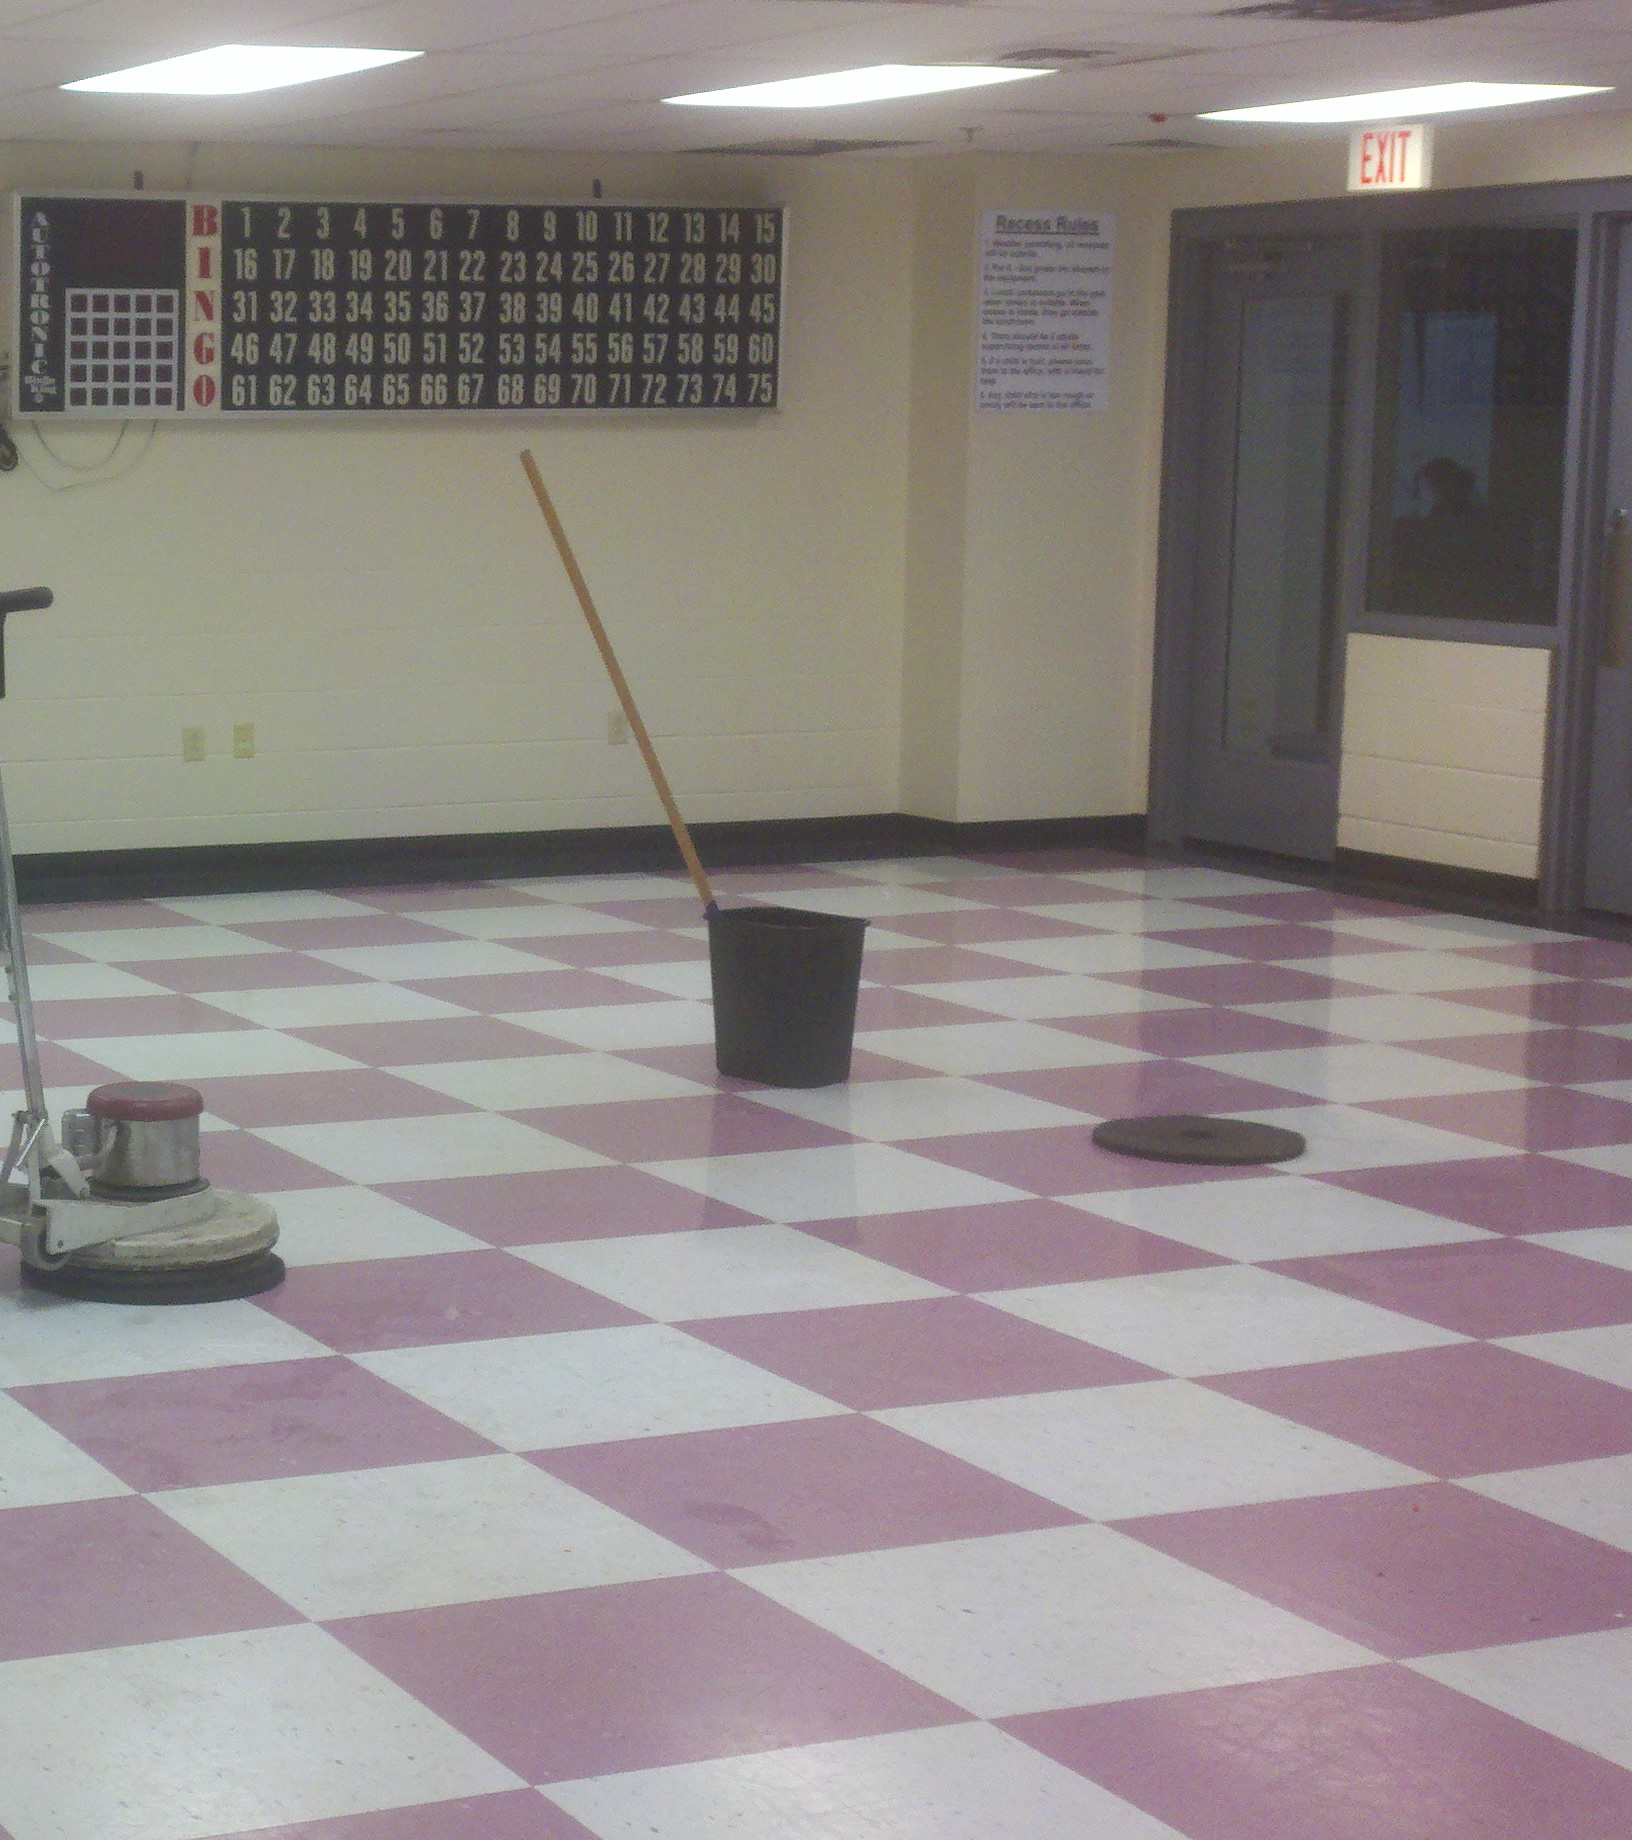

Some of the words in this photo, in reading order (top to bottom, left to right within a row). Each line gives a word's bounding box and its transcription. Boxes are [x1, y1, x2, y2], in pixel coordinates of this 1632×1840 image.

[1360, 130, 1412, 184] EXIT
[241, 206, 251, 237] 1
[278, 206, 291, 239] 2
[317, 207, 330, 239] 3
[354, 207, 367, 238] 4
[392, 207, 405, 240] 5
[430, 207, 443, 240] 6
[467, 209, 480, 239] 7
[506, 209, 519, 241] 8
[544, 210, 556, 241] 9
[577, 211, 597, 241] 10
[614, 212, 632, 241] 11
[648, 212, 669, 242] 12
[684, 212, 704, 243] 13
[720, 214, 739, 242] 14
[755, 214, 774, 243] 15
[995, 214, 1052, 231] Recess
[234, 248, 257, 280] 16
[273, 249, 295, 279] 17
[311, 248, 334, 280] 18
[349, 249, 372, 281] 19
[385, 249, 411, 281] 20
[424, 250, 447, 281] 21
[459, 250, 485, 281] 22
[500, 251, 526, 282] 23
[536, 252, 562, 282] 24
[572, 251, 598, 282] 25
[609, 251, 634, 282] 26
[644, 253, 670, 283] 27
[680, 253, 705, 283] 28
[716, 253, 741, 284] 29
[751, 254, 775, 283] 30
[191, 204, 219, 407] BINGO
[233, 290, 257, 322] 31
[270, 291, 297, 322] 32
[309, 291, 335, 322] 33
[346, 291, 373, 322] 34
[384, 291, 410, 322] 35
[422, 291, 448, 322] 36
[460, 291, 485, 322] 37
[500, 292, 525, 323] 38
[536, 293, 562, 323] 39
[572, 293, 598, 323] 40
[609, 293, 631, 322] 41
[644, 293, 669, 323] 42
[679, 293, 705, 323] 43
[715, 294, 740, 322] 44
[750, 294, 774, 322] 45
[231, 333, 259, 364] 46
[270, 333, 297, 363] 47
[308, 333, 336, 364] 48
[346, 333, 373, 364] 49
[384, 333, 410, 364] 50
[424, 333, 446, 363] 51
[459, 333, 484, 363] 52
[499, 333, 524, 364] 53
[535, 333, 561, 364] 54
[572, 333, 597, 364] 55
[608, 333, 633, 363] 56
[643, 334, 668, 363] 57
[678, 333, 703, 364] 58
[714, 334, 738, 364] 59
[749, 334, 773, 363] 60
[232, 374, 256, 406] 61
[270, 374, 296, 406] 62
[308, 374, 334, 405] 63
[345, 374, 371, 405] 64
[383, 374, 409, 405] 65
[421, 374, 447, 404] 66
[458, 374, 483, 404] 67
[498, 374, 523, 404] 68
[535, 374, 560, 404] 69
[572, 374, 596, 404] 70
[609, 374, 630, 403] 71
[642, 374, 666, 403] 72
[678, 374, 702, 403] 73
[713, 374, 736, 402] 74
[749, 374, 771, 402] 75
